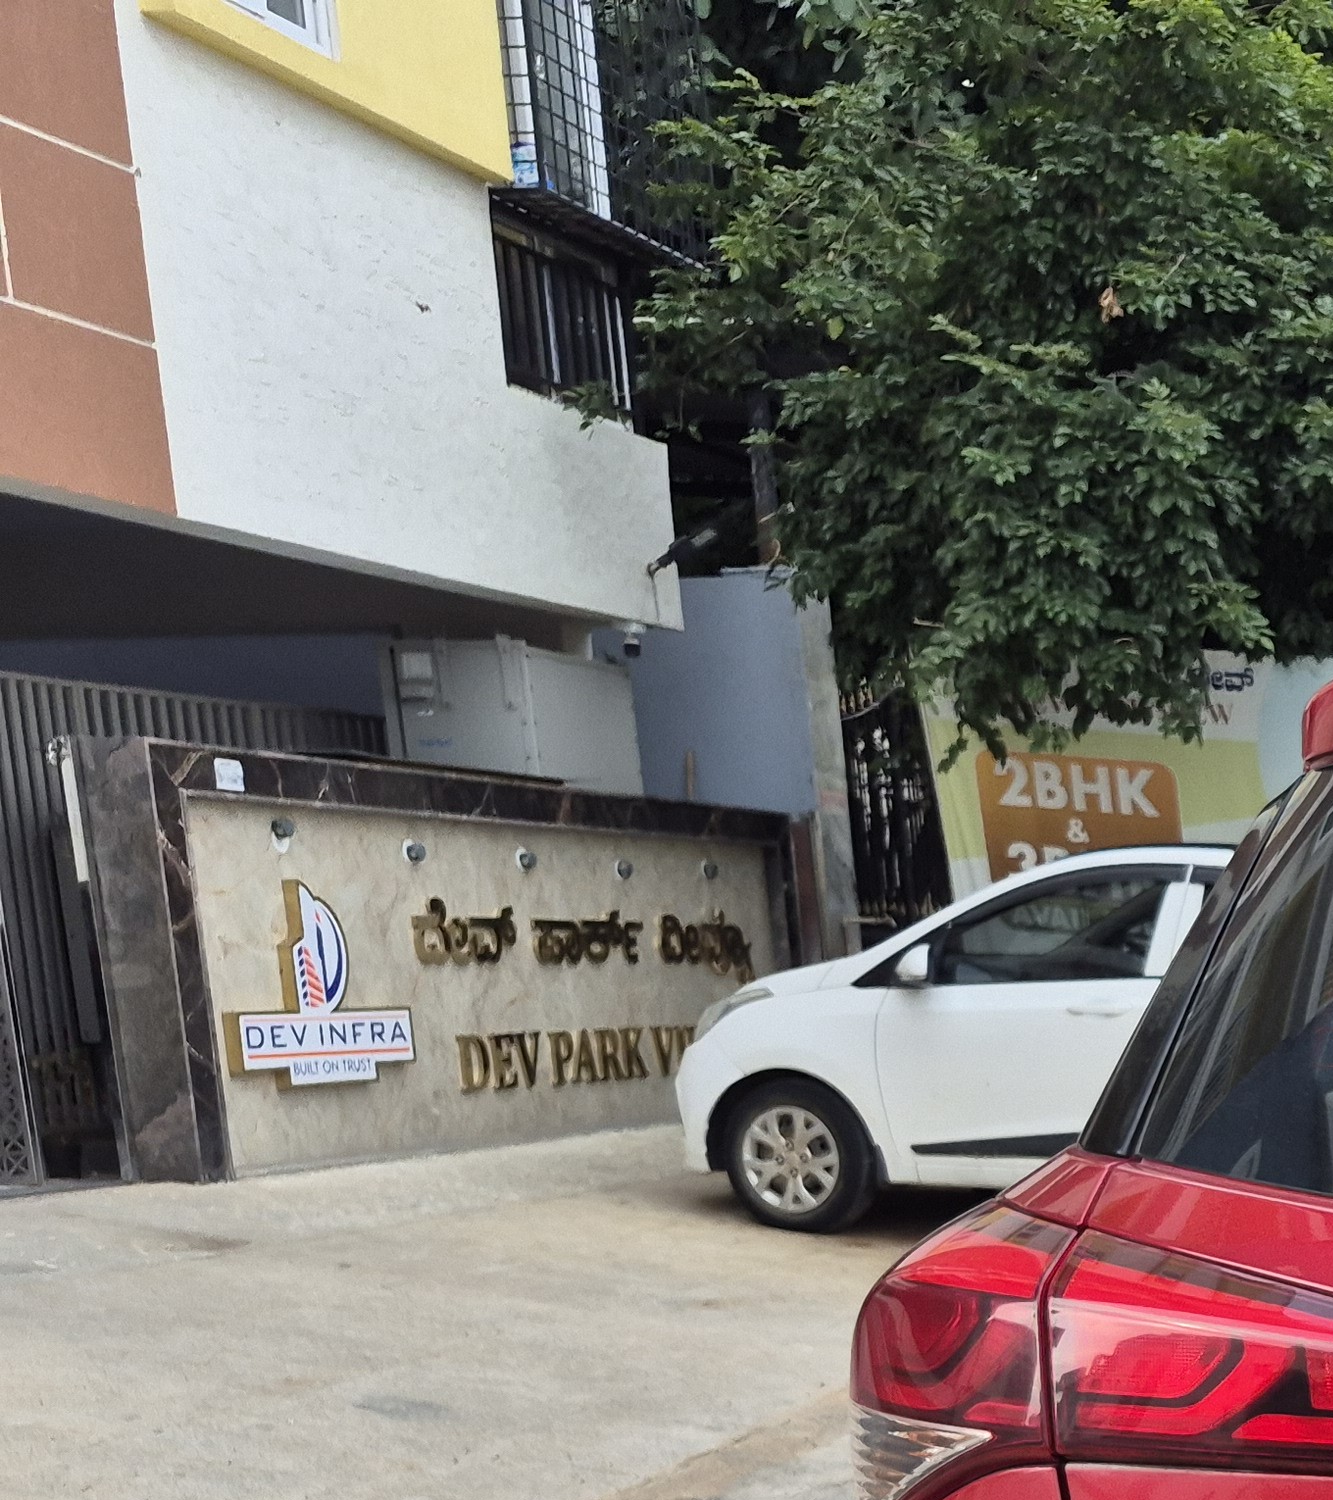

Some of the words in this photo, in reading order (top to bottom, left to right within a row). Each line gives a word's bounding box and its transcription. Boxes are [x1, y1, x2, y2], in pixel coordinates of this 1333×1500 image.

[994, 757, 1160, 818] 2BHK
[1067, 817, 1090, 844] &
[245, 1022, 307, 1050] DEV
[319, 1020, 408, 1047] INFRA
[293, 1062, 319, 1077] BUILT
[322, 1061, 340, 1075] ON
[343, 1058, 372, 1073] TRUST
[455, 1030, 541, 1093] DEV
[548, 1026, 650, 1087] PARK
